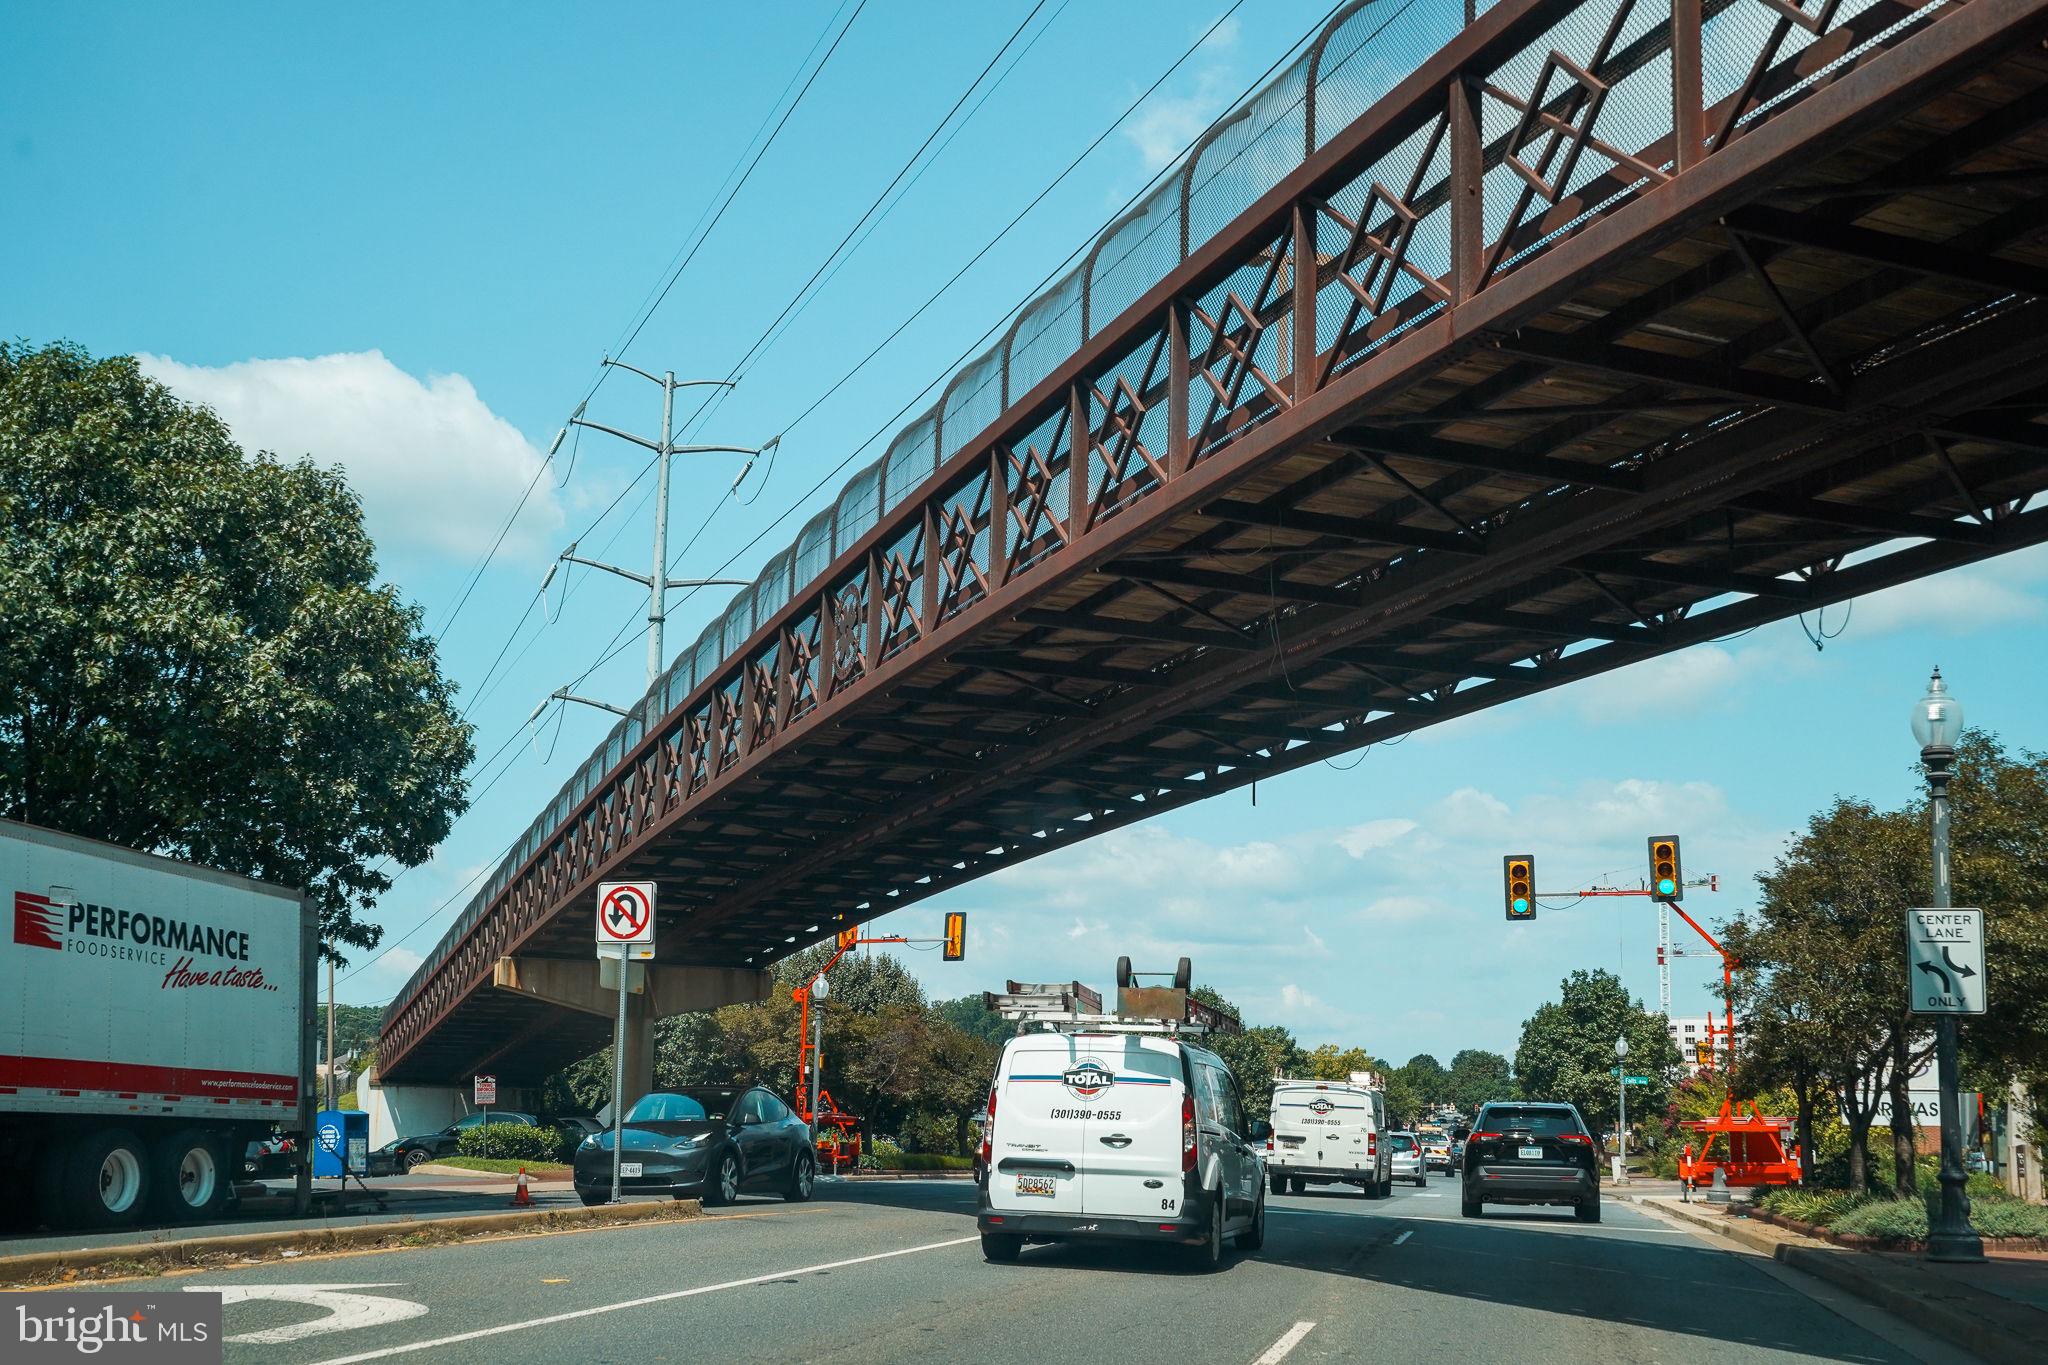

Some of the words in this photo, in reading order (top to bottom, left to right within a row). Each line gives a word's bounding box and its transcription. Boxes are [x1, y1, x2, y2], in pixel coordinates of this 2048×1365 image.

[1917, 914, 1972, 925] CENTER
[68, 902, 249, 961] PERFORMANCE
[1926, 928, 1964, 938] LANE
[67, 938, 166, 966] FOODSERVICE
[161, 955, 210, 990] Have
[1927, 996, 1967, 1007] ONLY
[200, 1078, 294, 1092] www.performancefoodservice.com
[1065, 1072, 1111, 1086] TOTAL
[1310, 1103, 1334, 1111] TOTAL
[1050, 1108, 1122, 1121] (301)390-0555
[1160, 1198, 1175, 1211] 84
